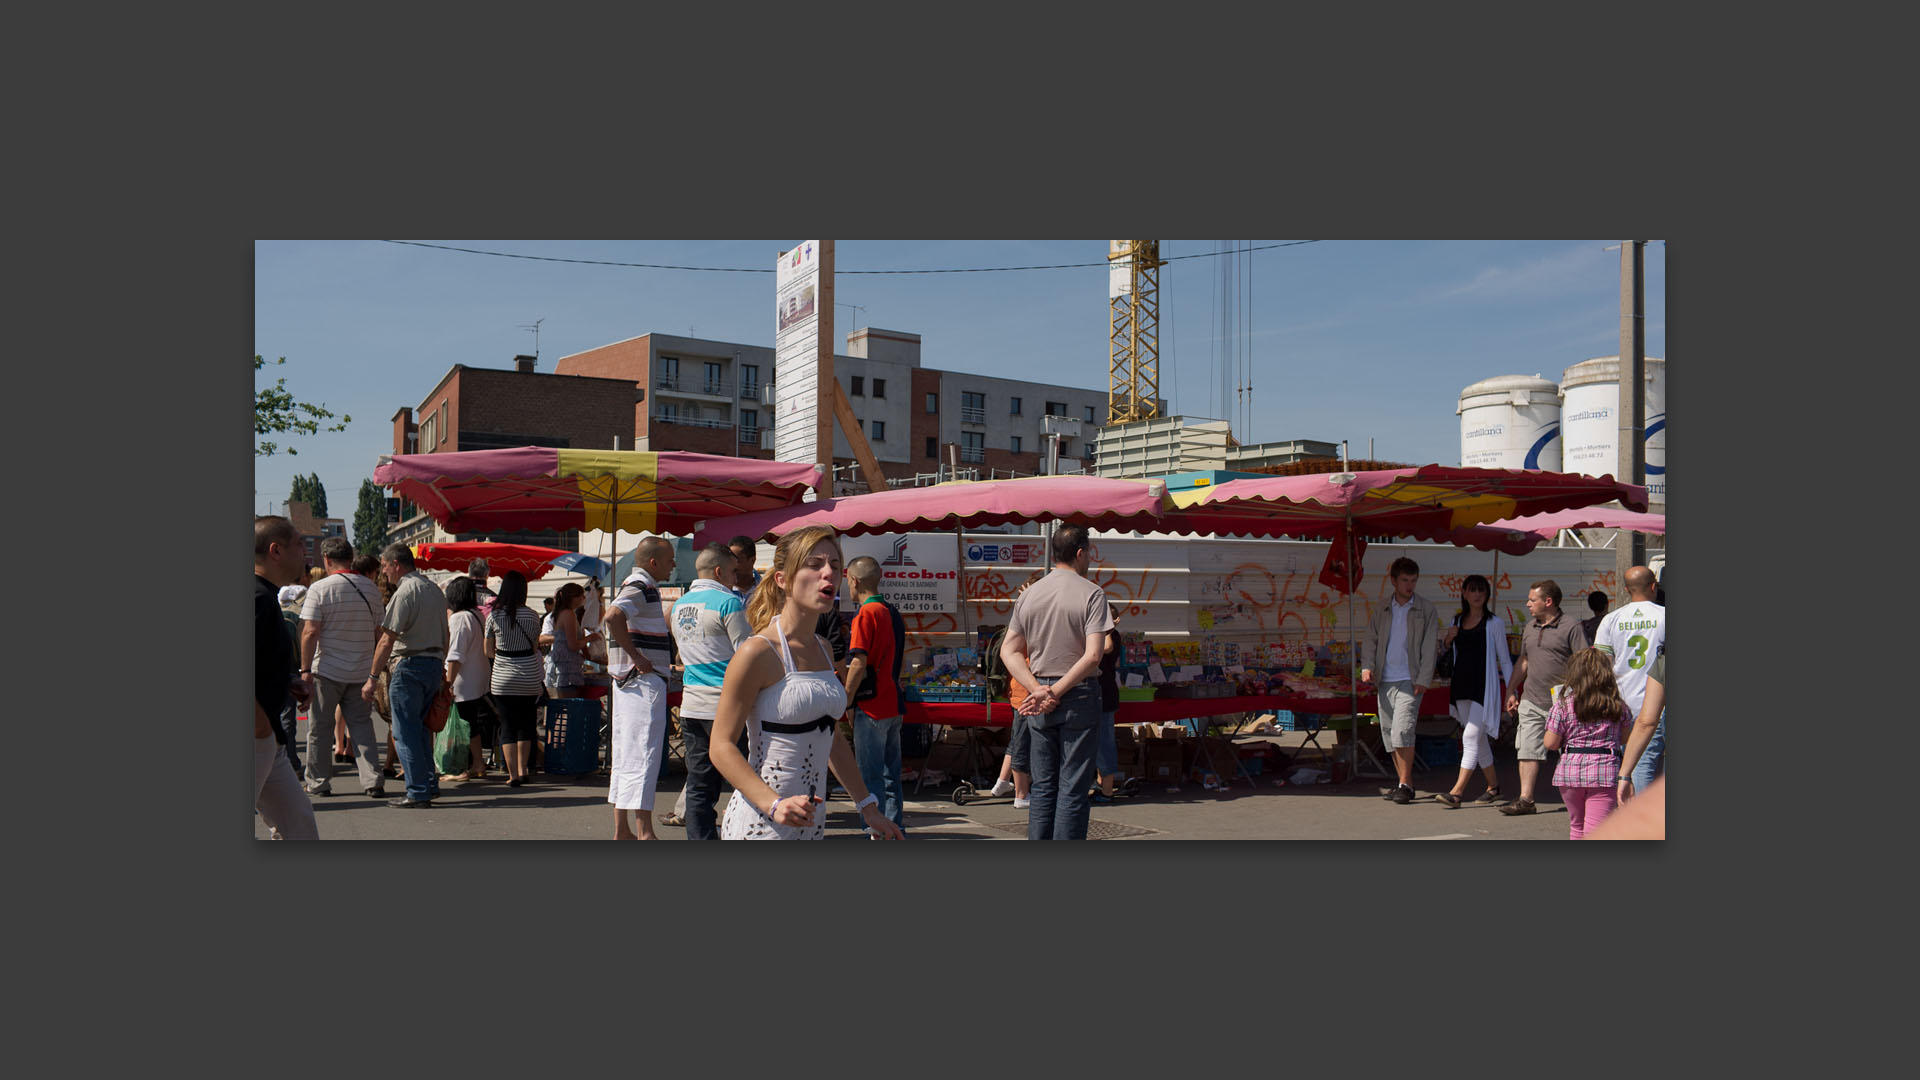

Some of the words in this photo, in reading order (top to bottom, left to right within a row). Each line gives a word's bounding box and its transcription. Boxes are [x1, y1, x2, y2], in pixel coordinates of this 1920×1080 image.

[893, 593, 937, 601] CAESTRE
[903, 603, 915, 611] 40
[918, 603, 930, 611] 10
[933, 603, 944, 611] 61
[1619, 620, 1657, 631] BELHADJ
[1628, 635, 1648, 669] 3
